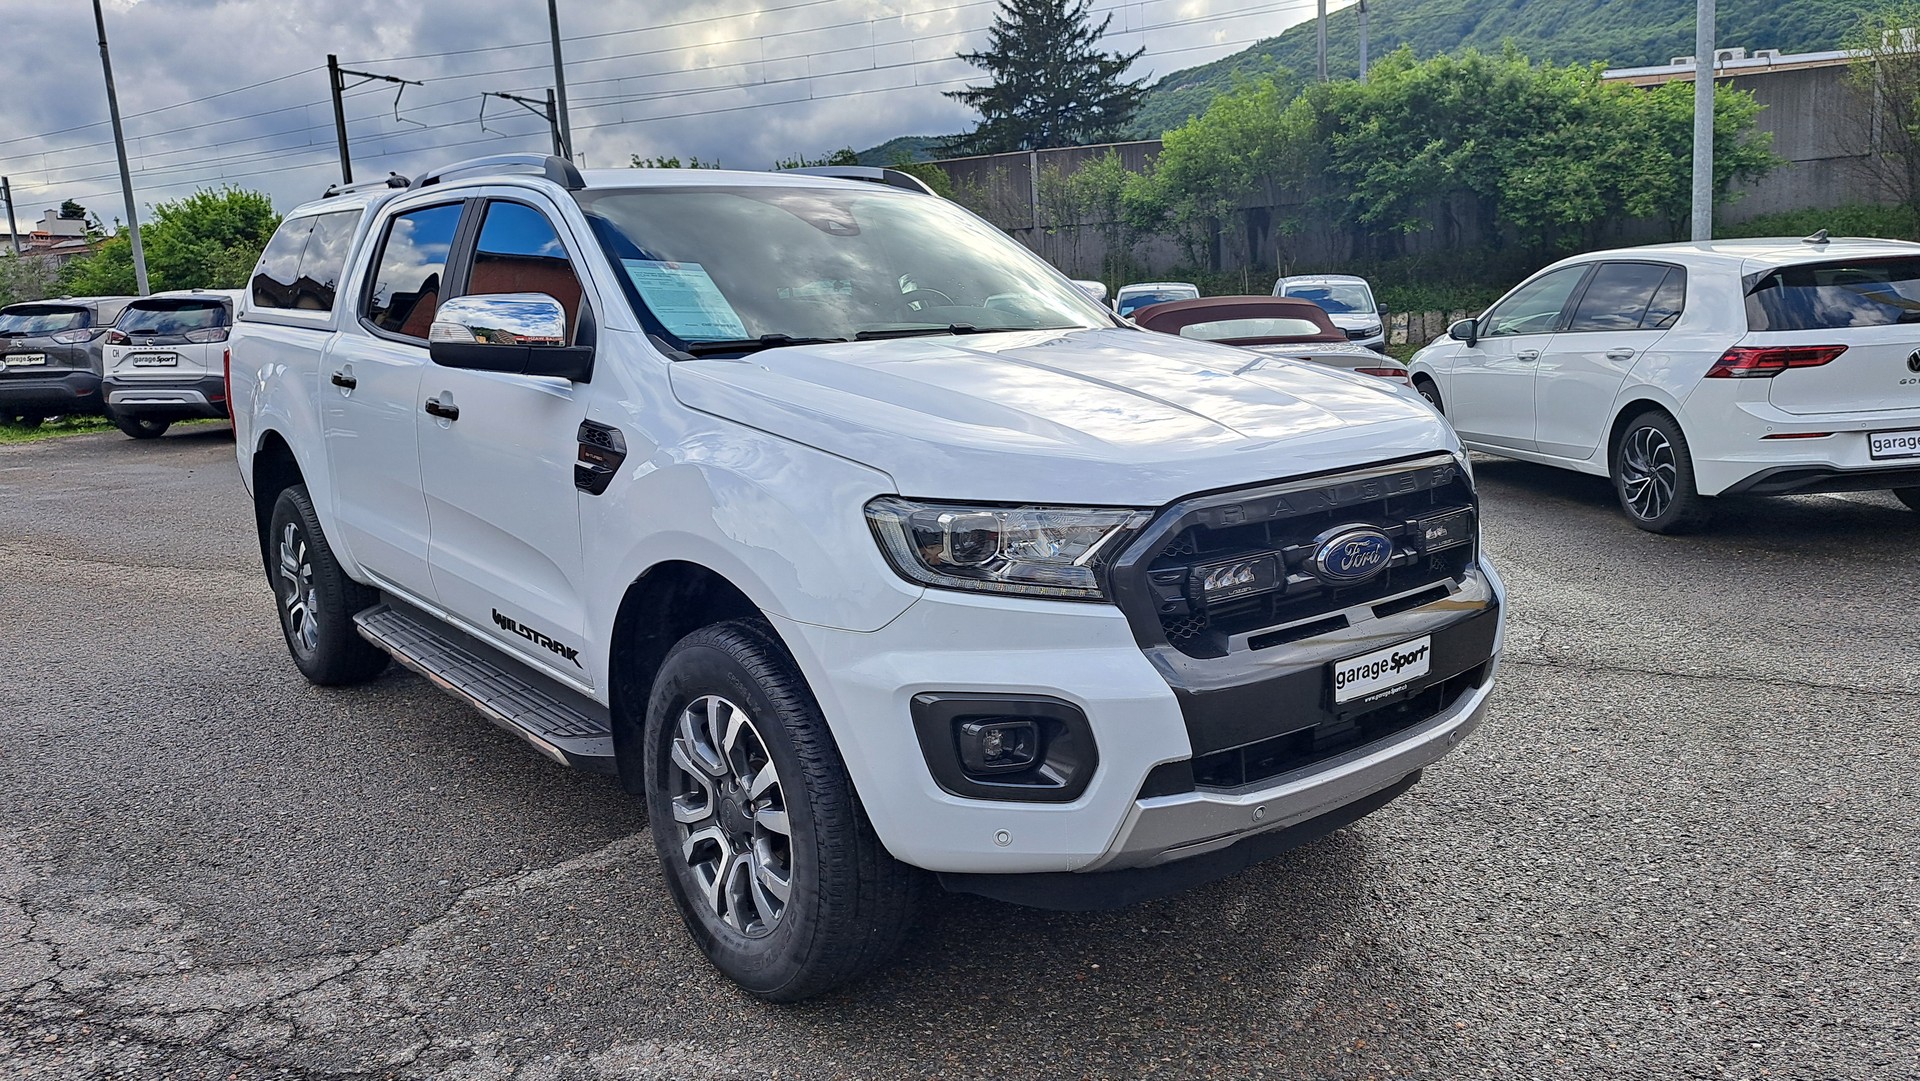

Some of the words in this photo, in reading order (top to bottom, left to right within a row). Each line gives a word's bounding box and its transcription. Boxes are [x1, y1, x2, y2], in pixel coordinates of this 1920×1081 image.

[112, 349, 120, 358] CH
[1341, 539, 1381, 571] Ford
[491, 607, 584, 670] WILDTRAK
